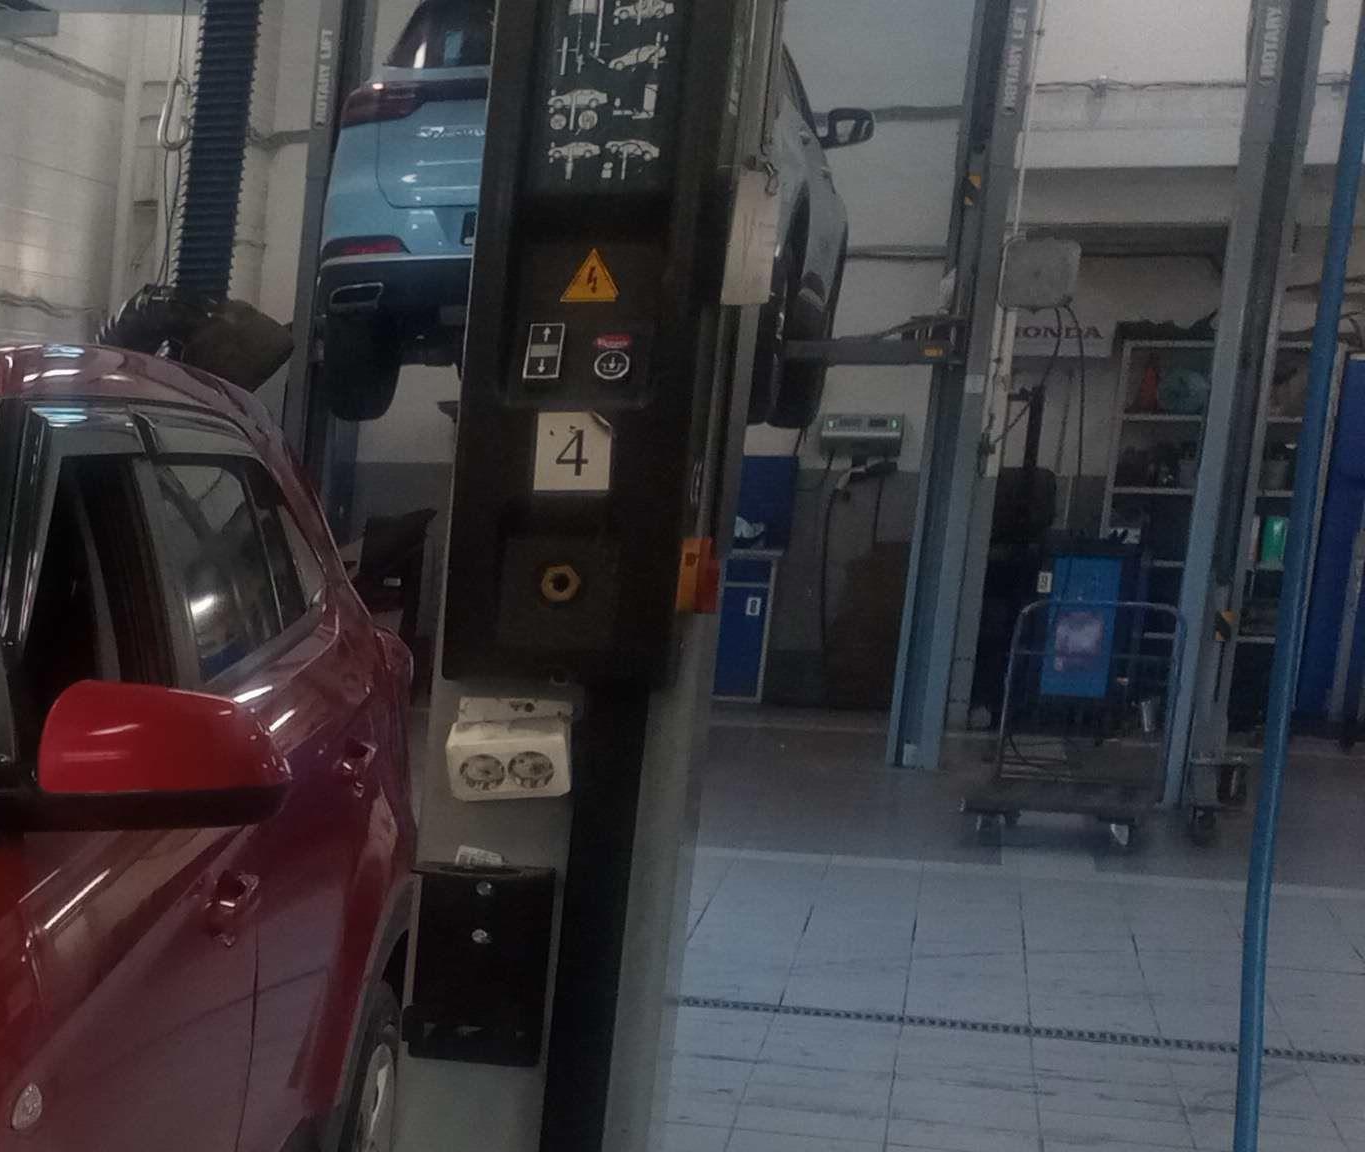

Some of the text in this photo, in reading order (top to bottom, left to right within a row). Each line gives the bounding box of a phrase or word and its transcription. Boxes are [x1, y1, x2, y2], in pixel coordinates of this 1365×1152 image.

[1260, 7, 1282, 78] ROTARY
[1004, 47, 1023, 107] ROTARY
[1015, 325, 1103, 339] ONDA
[555, 429, 589, 476] 4
